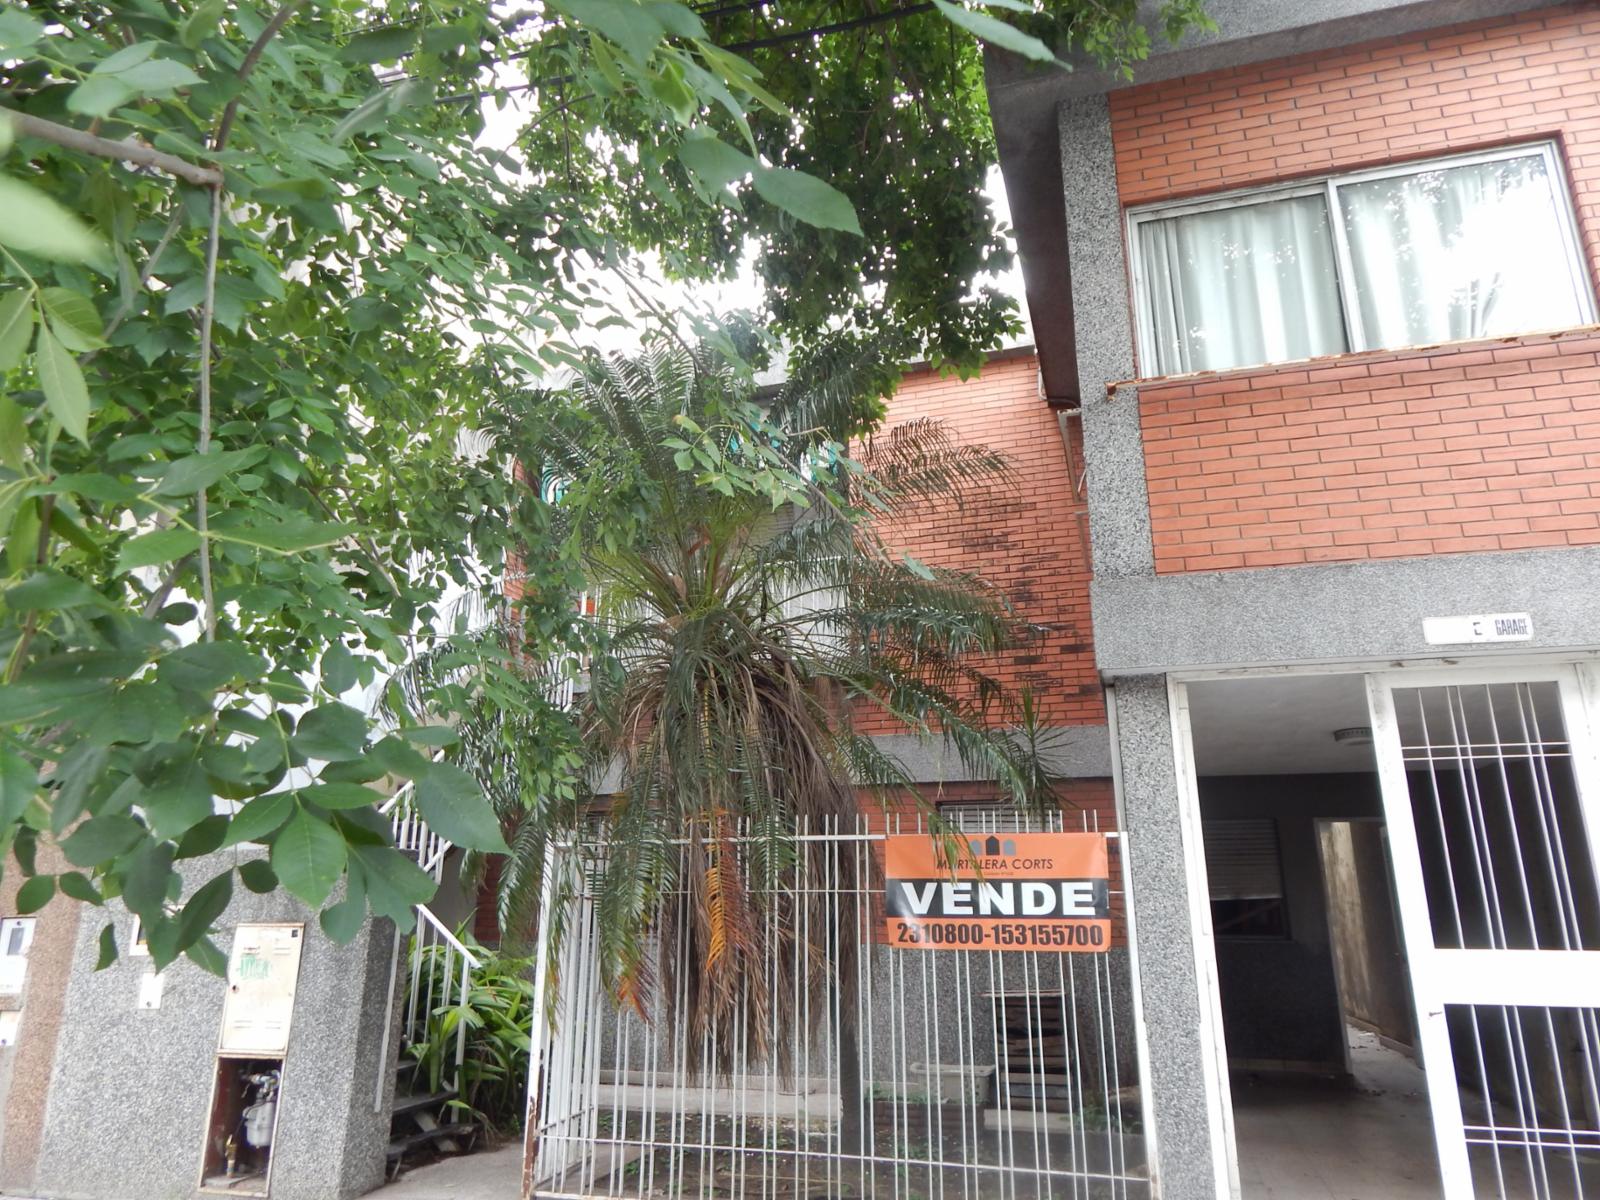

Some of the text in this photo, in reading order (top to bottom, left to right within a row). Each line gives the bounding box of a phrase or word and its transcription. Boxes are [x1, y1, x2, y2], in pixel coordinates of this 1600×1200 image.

[1495, 618, 1529, 636] GARAGE
[1012, 858, 1053, 870] CORTS
[901, 881, 1096, 916] VENDE
[897, 922, 1103, 946] 2310800-153155700
